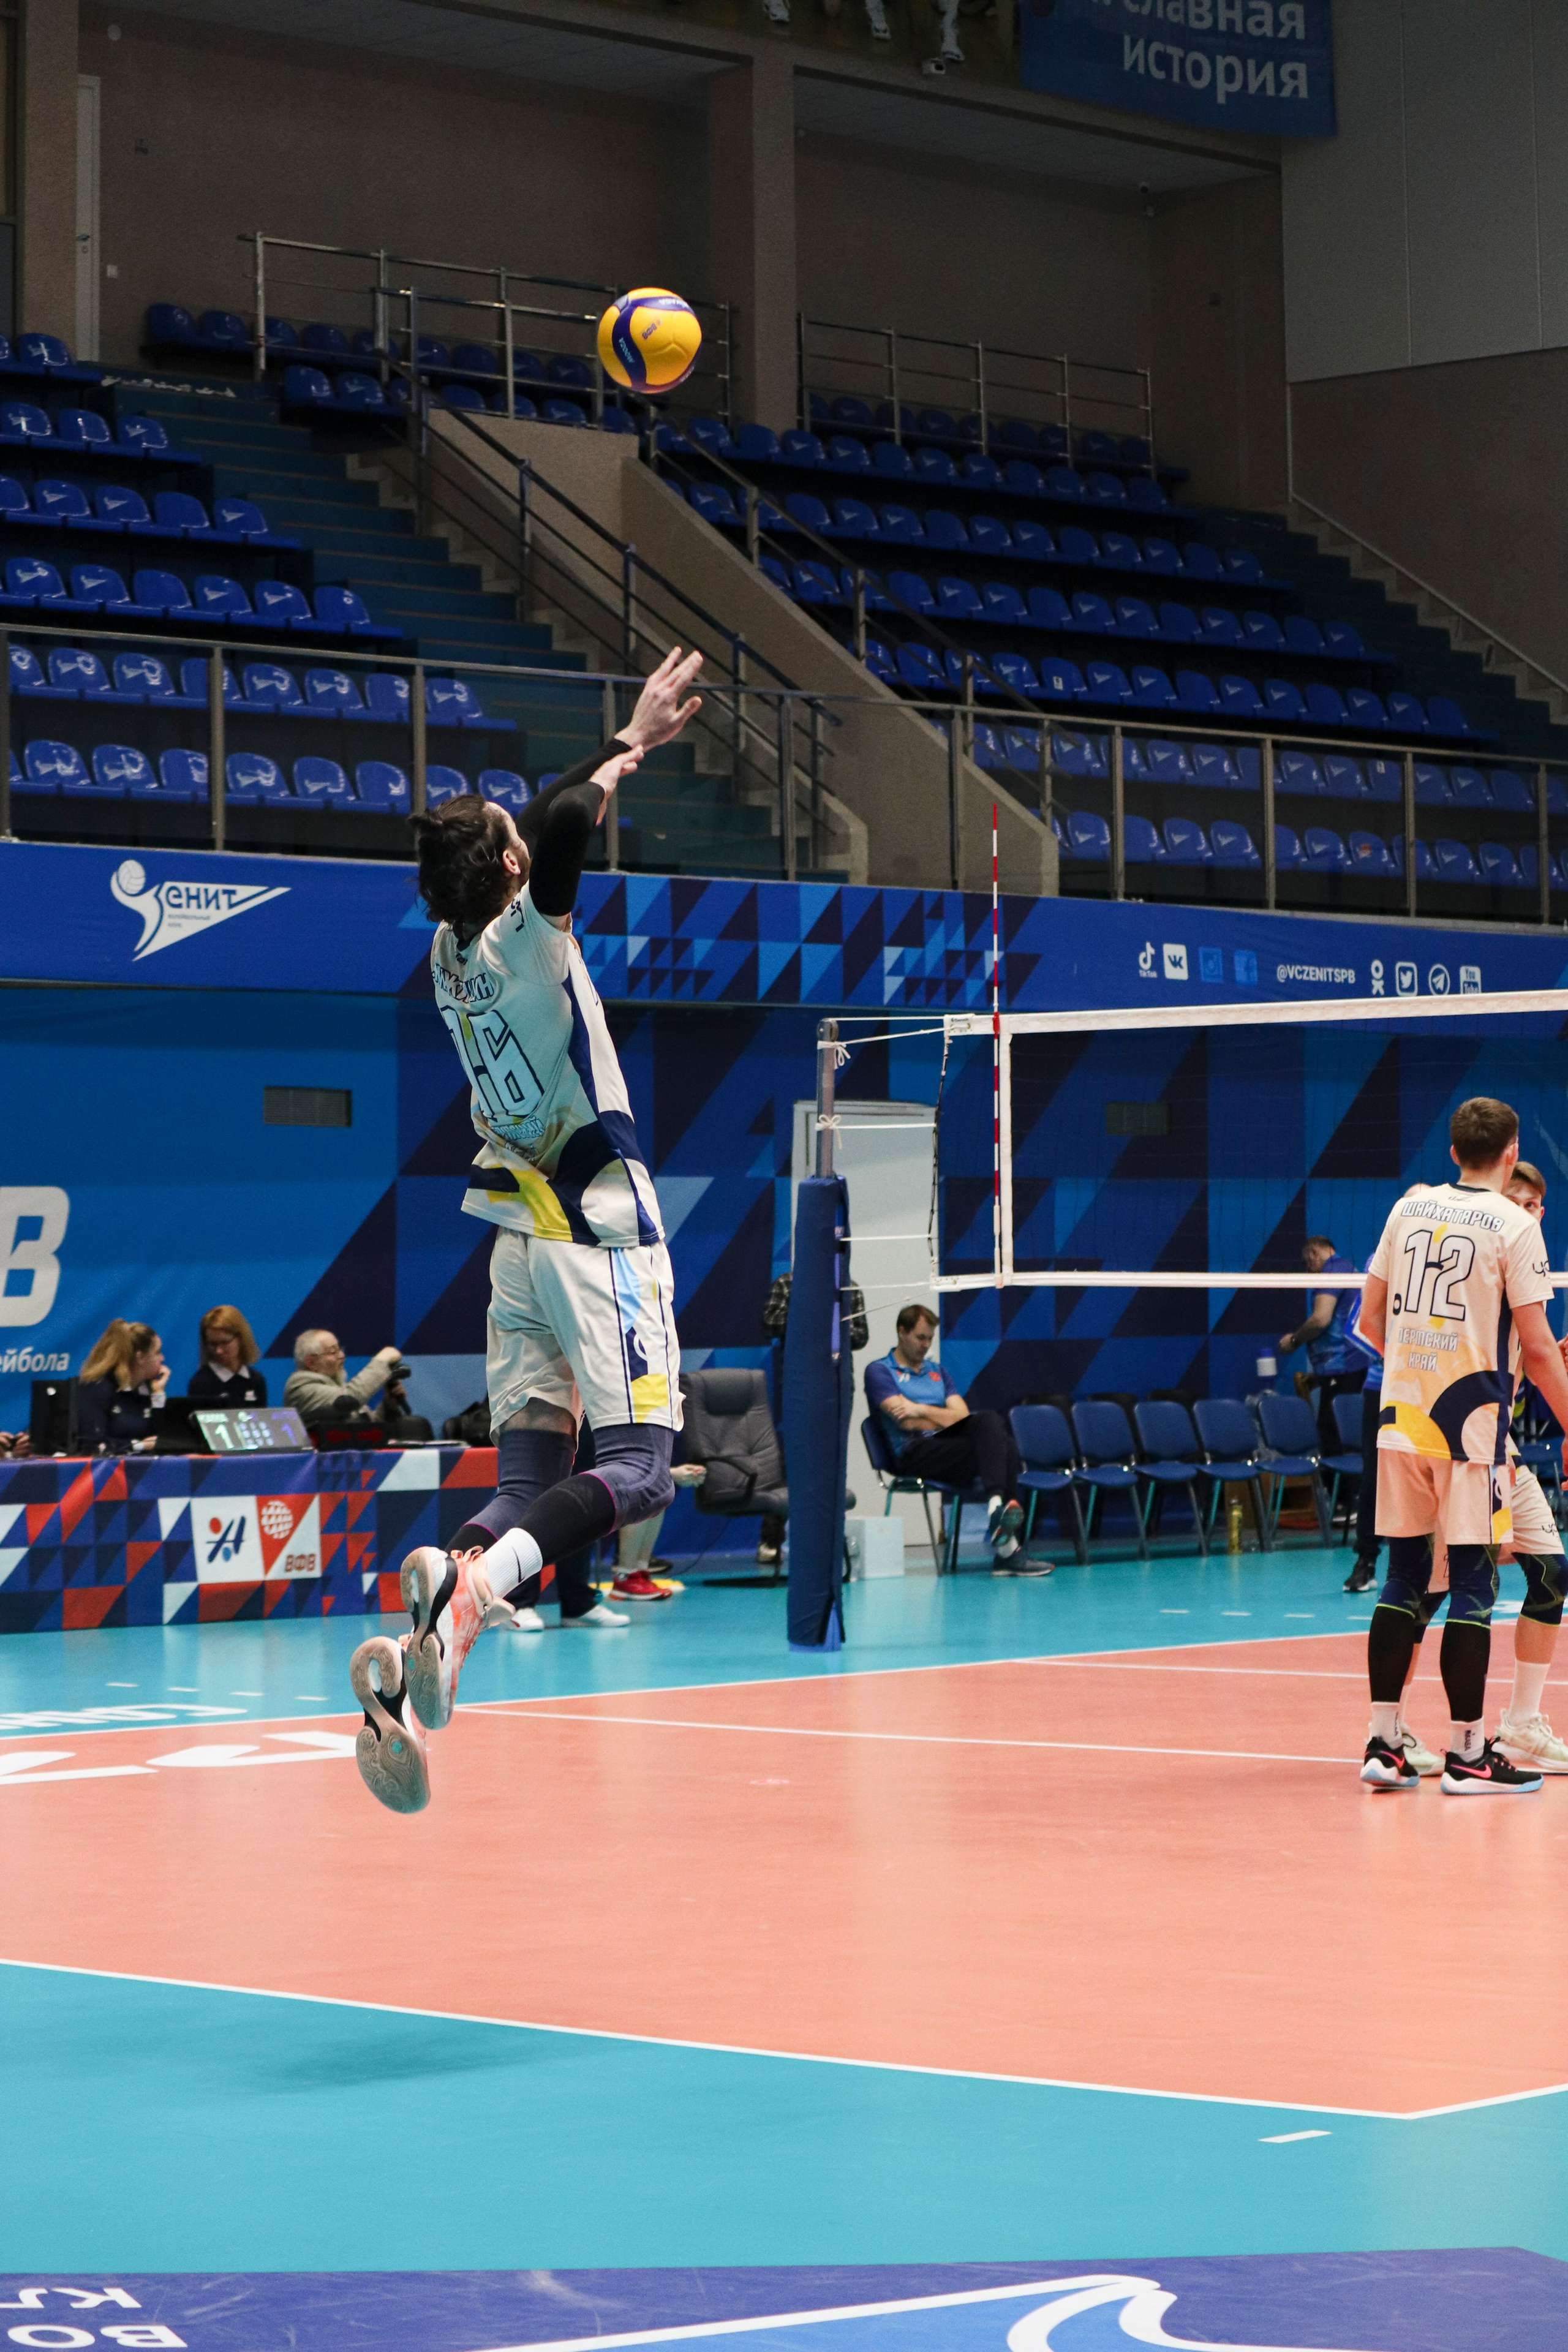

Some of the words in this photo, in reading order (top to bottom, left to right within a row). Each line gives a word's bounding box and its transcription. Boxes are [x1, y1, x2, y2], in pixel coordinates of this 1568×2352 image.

[1123, 34, 1308, 104] история
[1277, 964, 1355, 984] @VCZENITSPB
[1401, 1199, 1504, 1232] ШАЙХАТАРОВ
[1404, 1229, 1476, 1322] 12
[0, 1347, 70, 1373] йбола
[1408, 1351, 1438, 1372] КРАЙ
